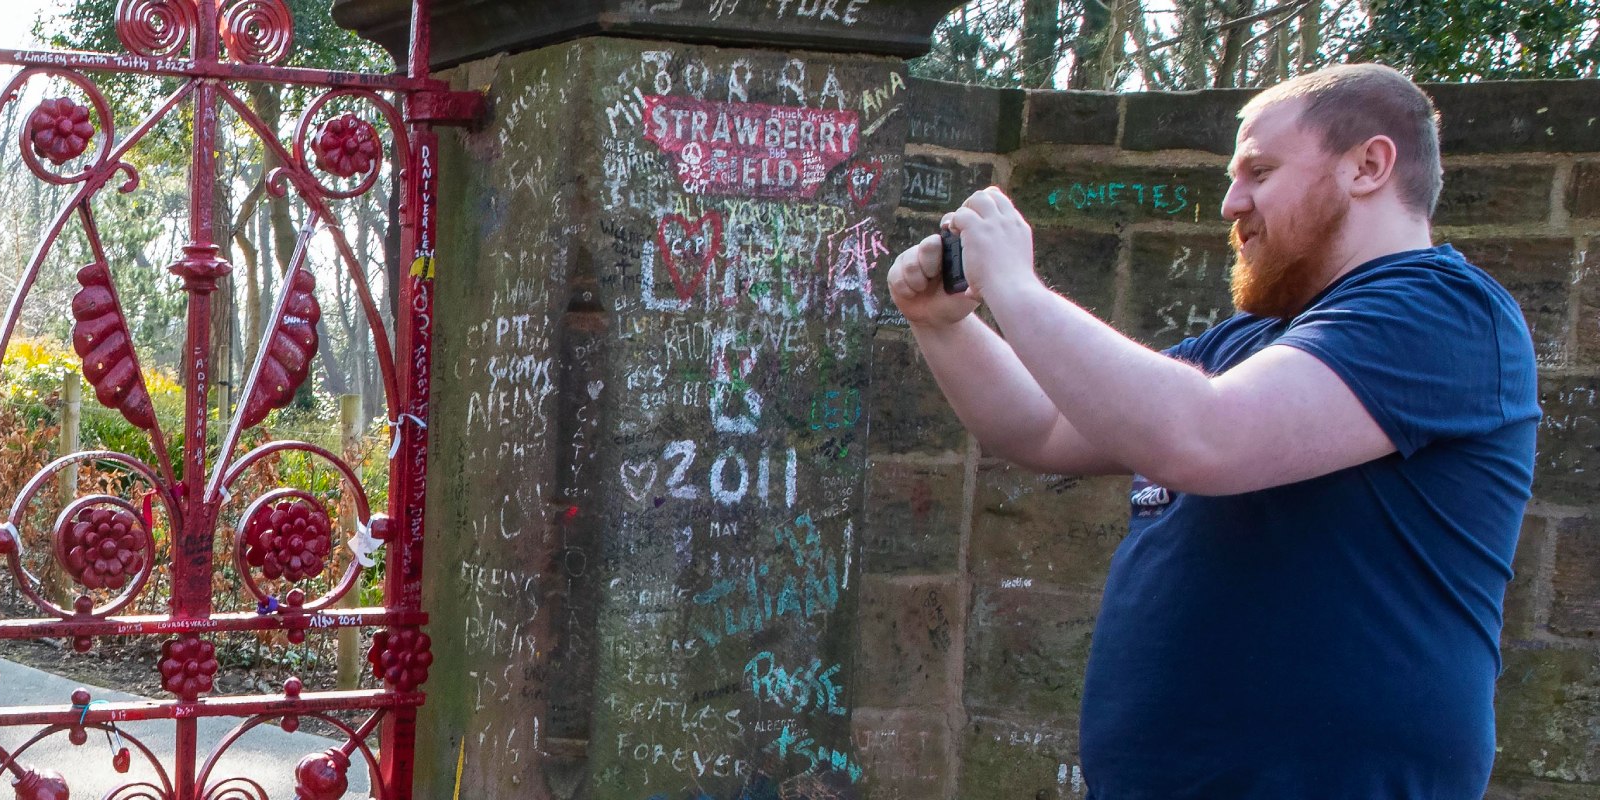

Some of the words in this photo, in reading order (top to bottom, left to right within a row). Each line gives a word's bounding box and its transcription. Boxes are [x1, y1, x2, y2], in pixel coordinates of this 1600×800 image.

[24, 53, 67, 66] Lindsey
[157, 61, 185, 71] 2022
[651, 103, 856, 154] STRAWBERRY
[708, 149, 798, 188] FIELD
[662, 440, 798, 507] 2011
[709, 521, 739, 538] MAY
[338, 615, 362, 626] 2021
[615, 731, 750, 779] FOREVER
